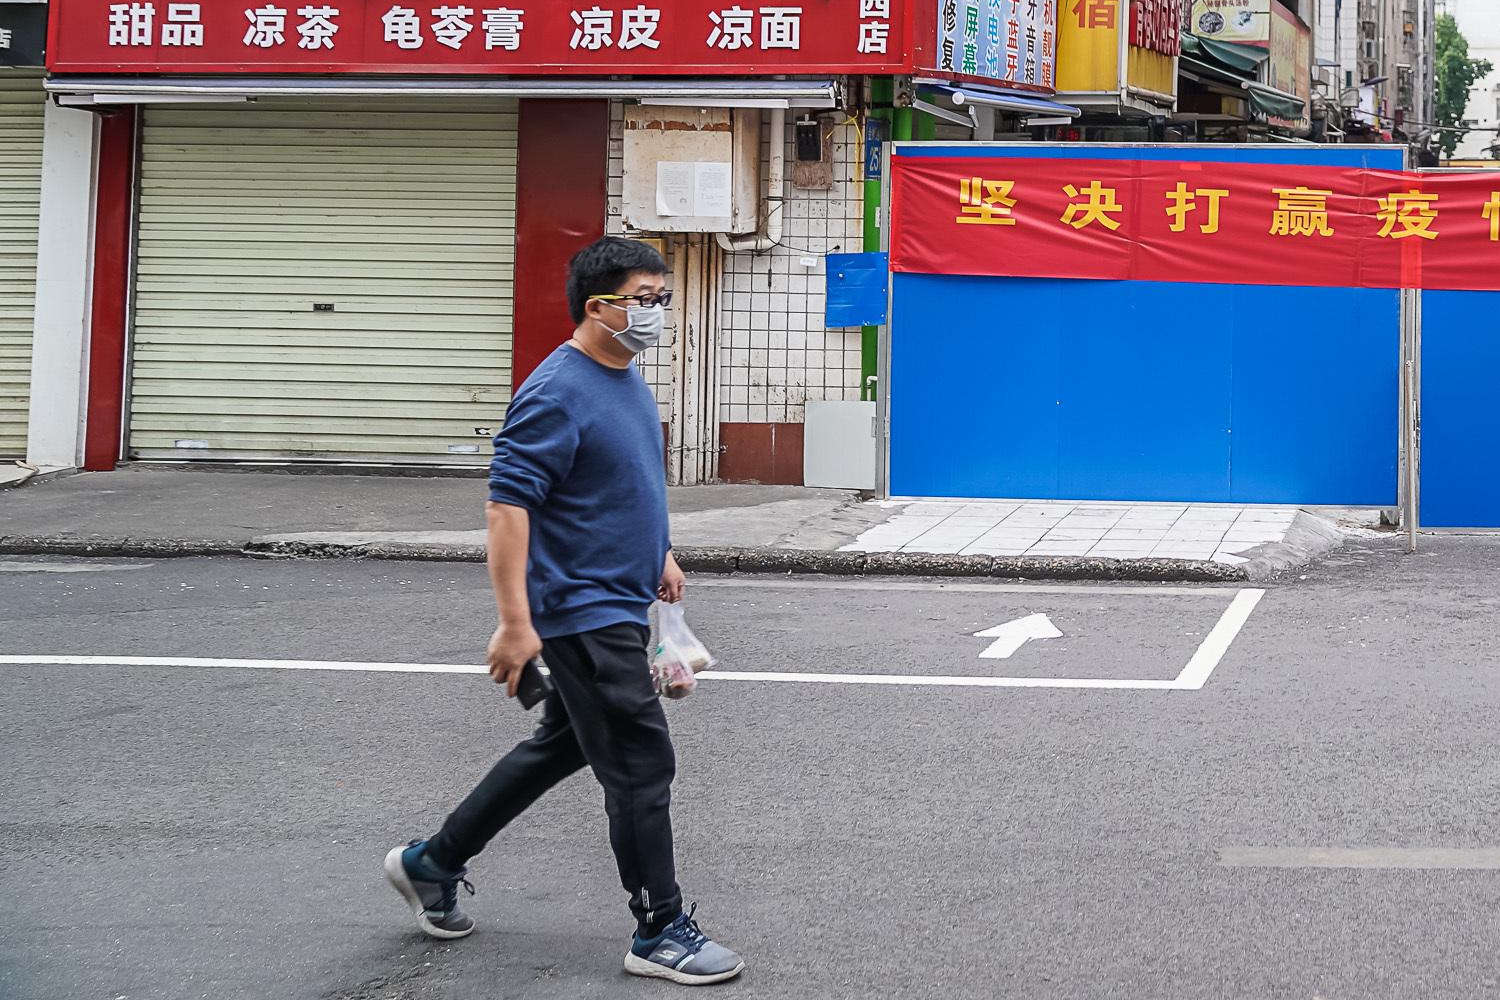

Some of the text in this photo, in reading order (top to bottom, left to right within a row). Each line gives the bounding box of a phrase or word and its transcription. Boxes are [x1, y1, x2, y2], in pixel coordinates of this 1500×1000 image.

[108, 2, 803, 51] 甜品 凉茶 龟苓膏 凉皮 凉面
